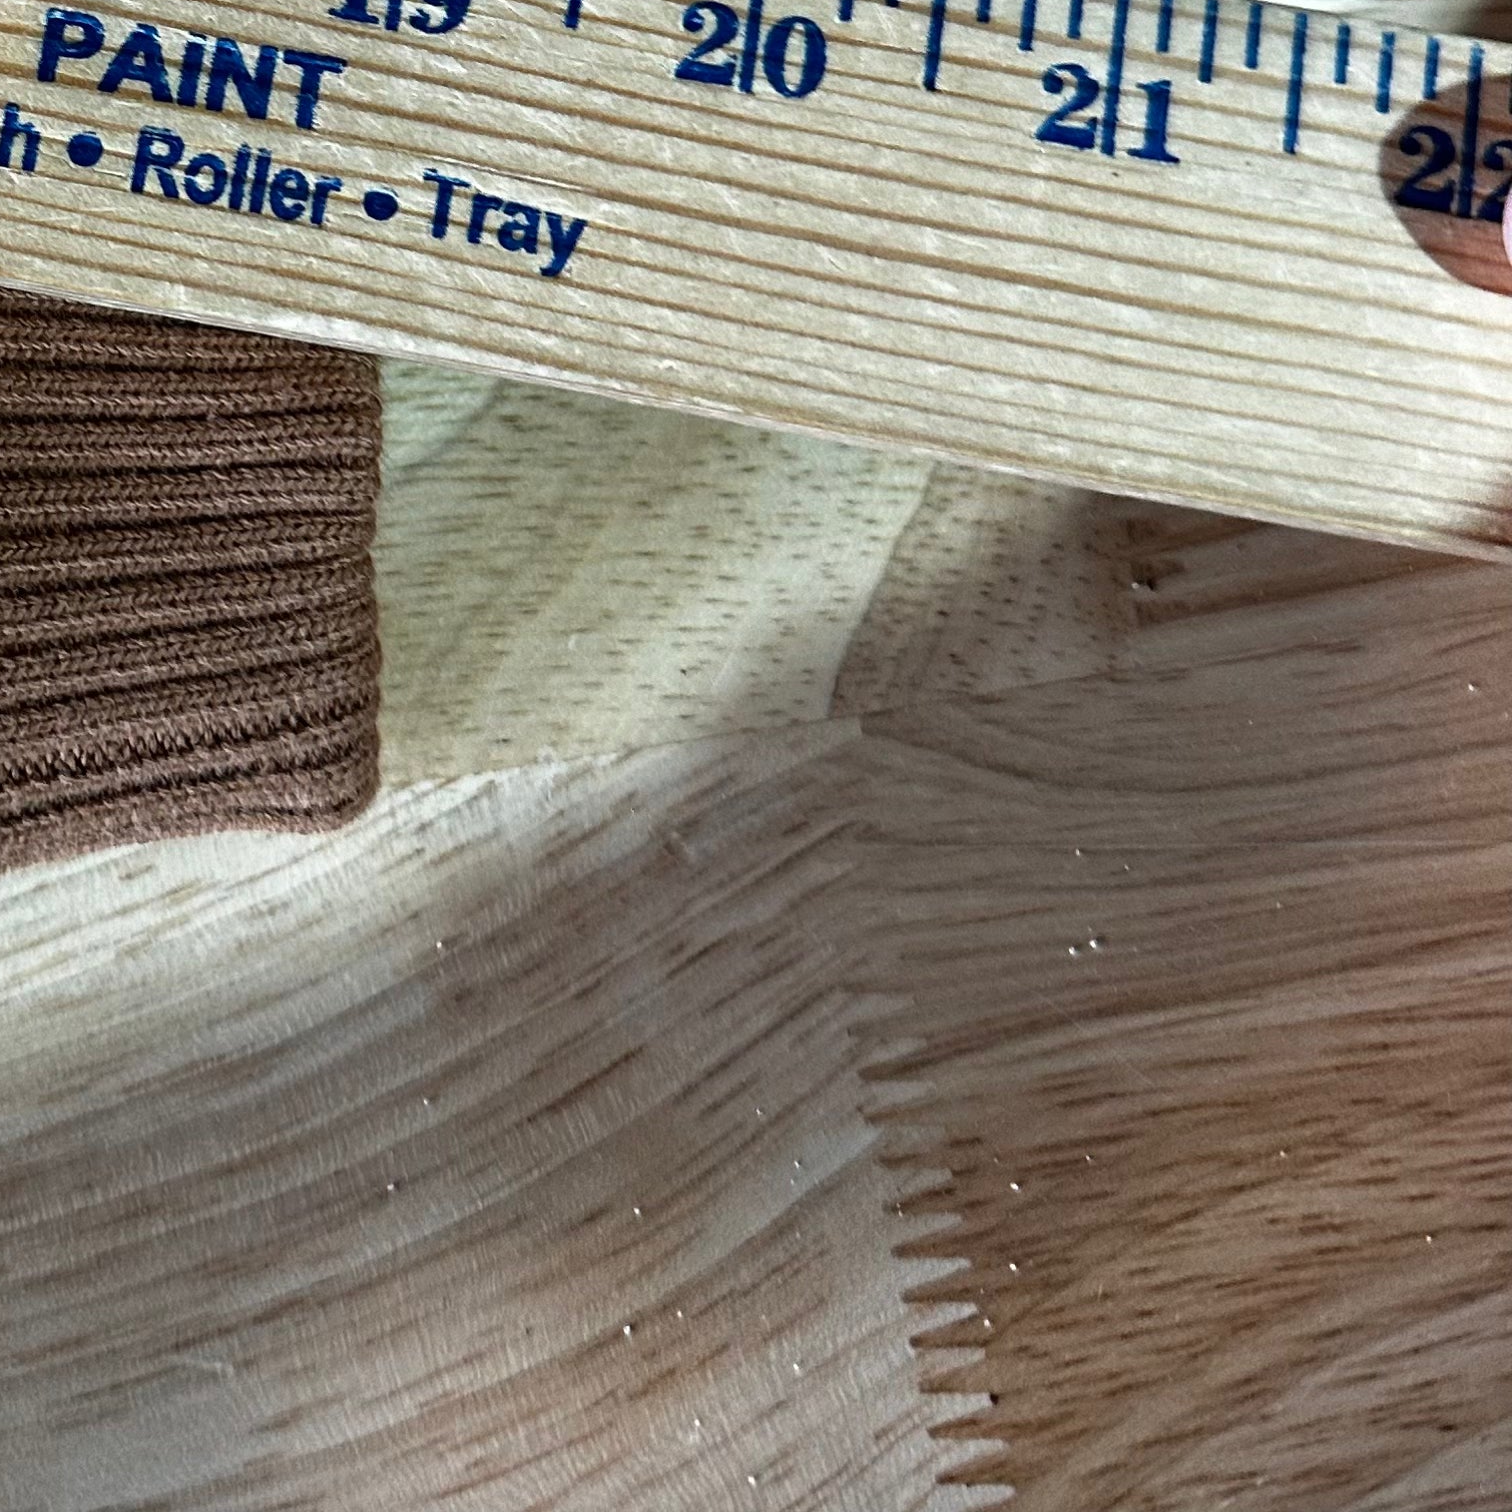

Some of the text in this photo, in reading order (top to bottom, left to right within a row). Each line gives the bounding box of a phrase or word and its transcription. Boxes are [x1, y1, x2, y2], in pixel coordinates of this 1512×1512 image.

[36, 8, 348, 131] PAINT
[674, 0, 827, 99] 20
[1035, 63, 1180, 164] 21
[131, 126, 342, 227] Roller
[421, 168, 590, 278] Tray
